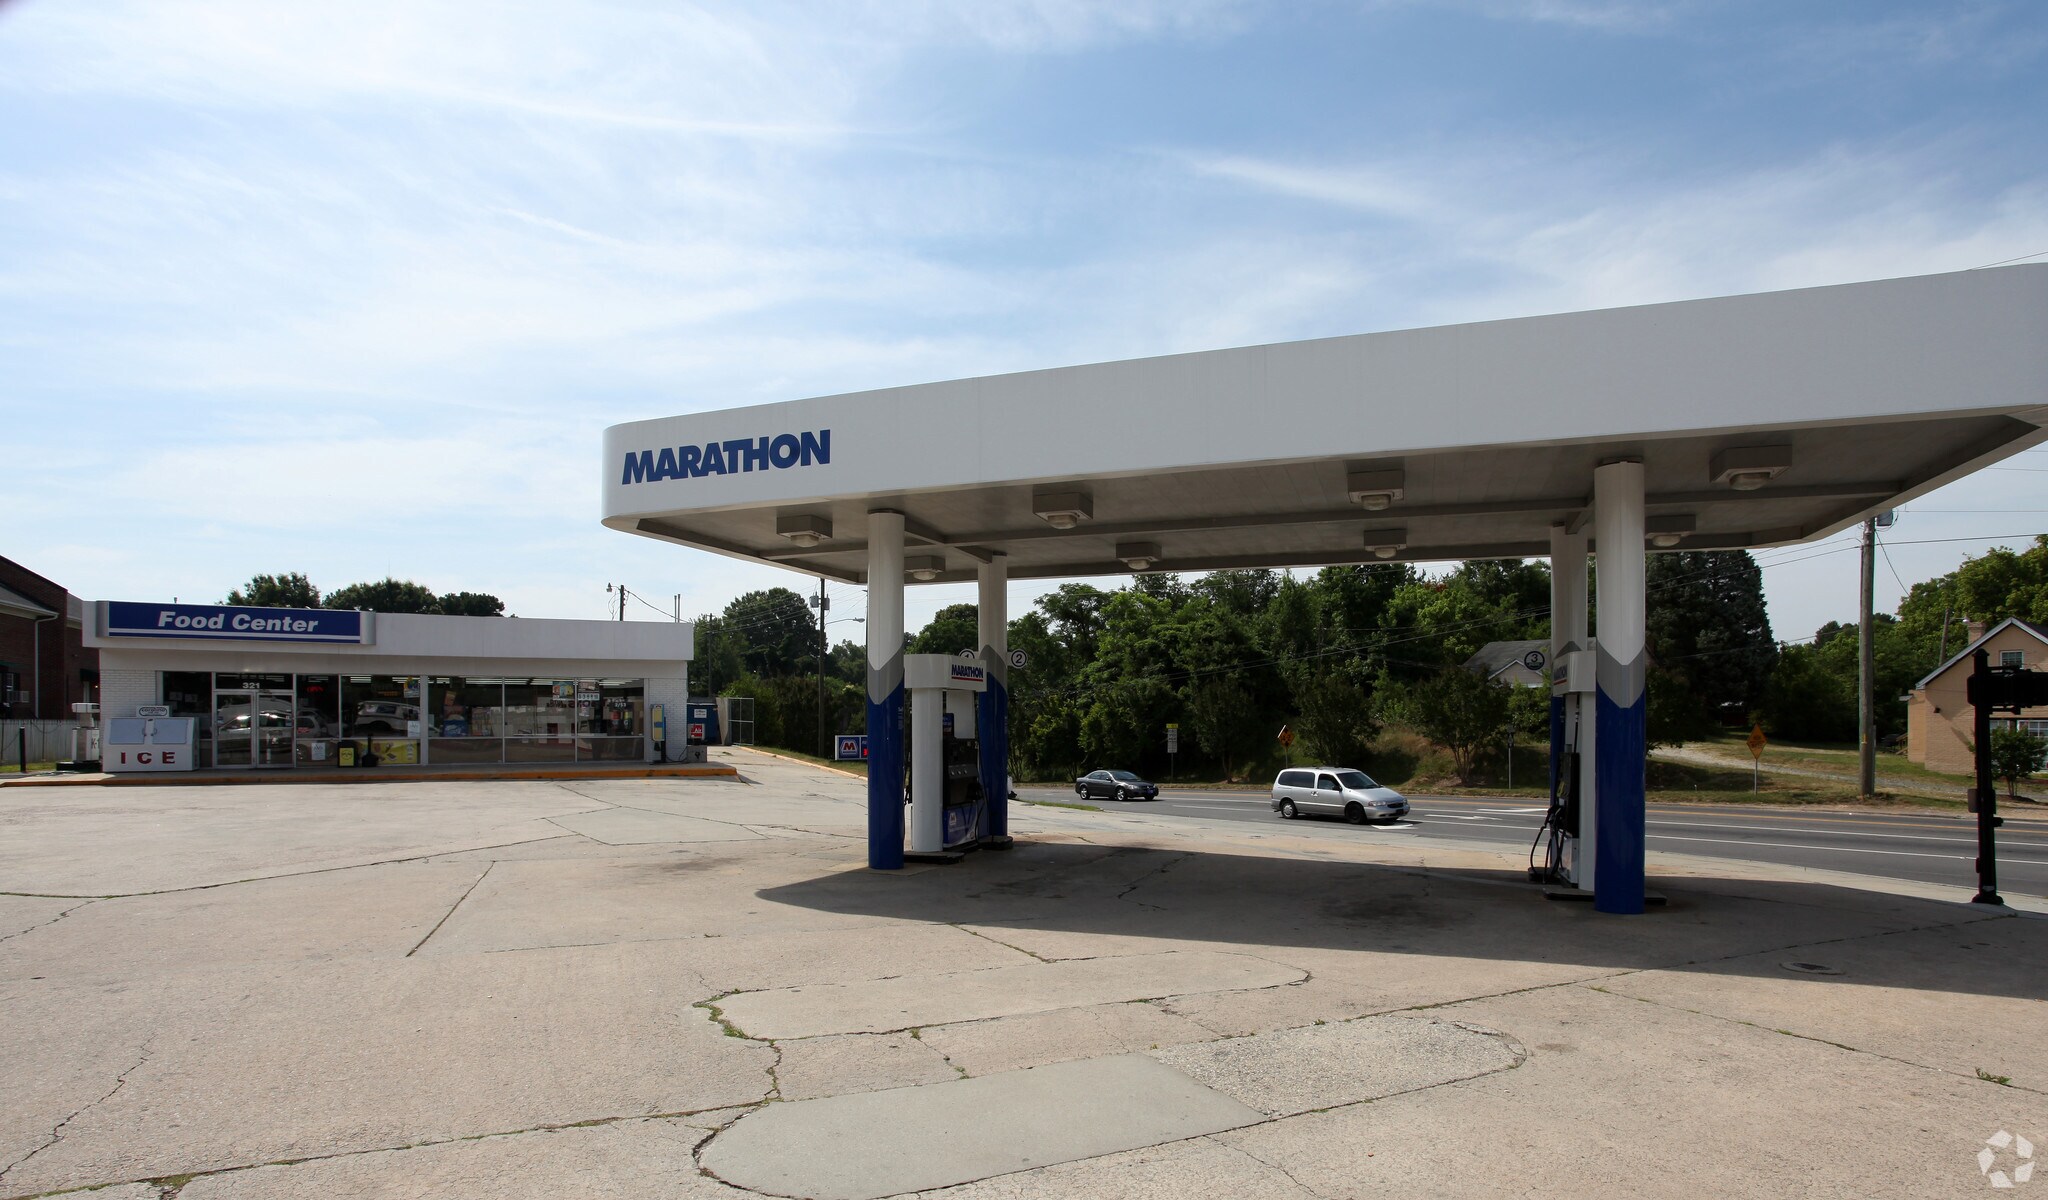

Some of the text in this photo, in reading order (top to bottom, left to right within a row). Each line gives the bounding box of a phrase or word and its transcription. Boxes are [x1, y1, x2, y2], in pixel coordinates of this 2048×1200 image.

[622, 429, 831, 485] MARATHON
[158, 611, 319, 632] Food Center
[951, 664, 984, 678] MARATHON
[120, 752, 176, 764] ICE
